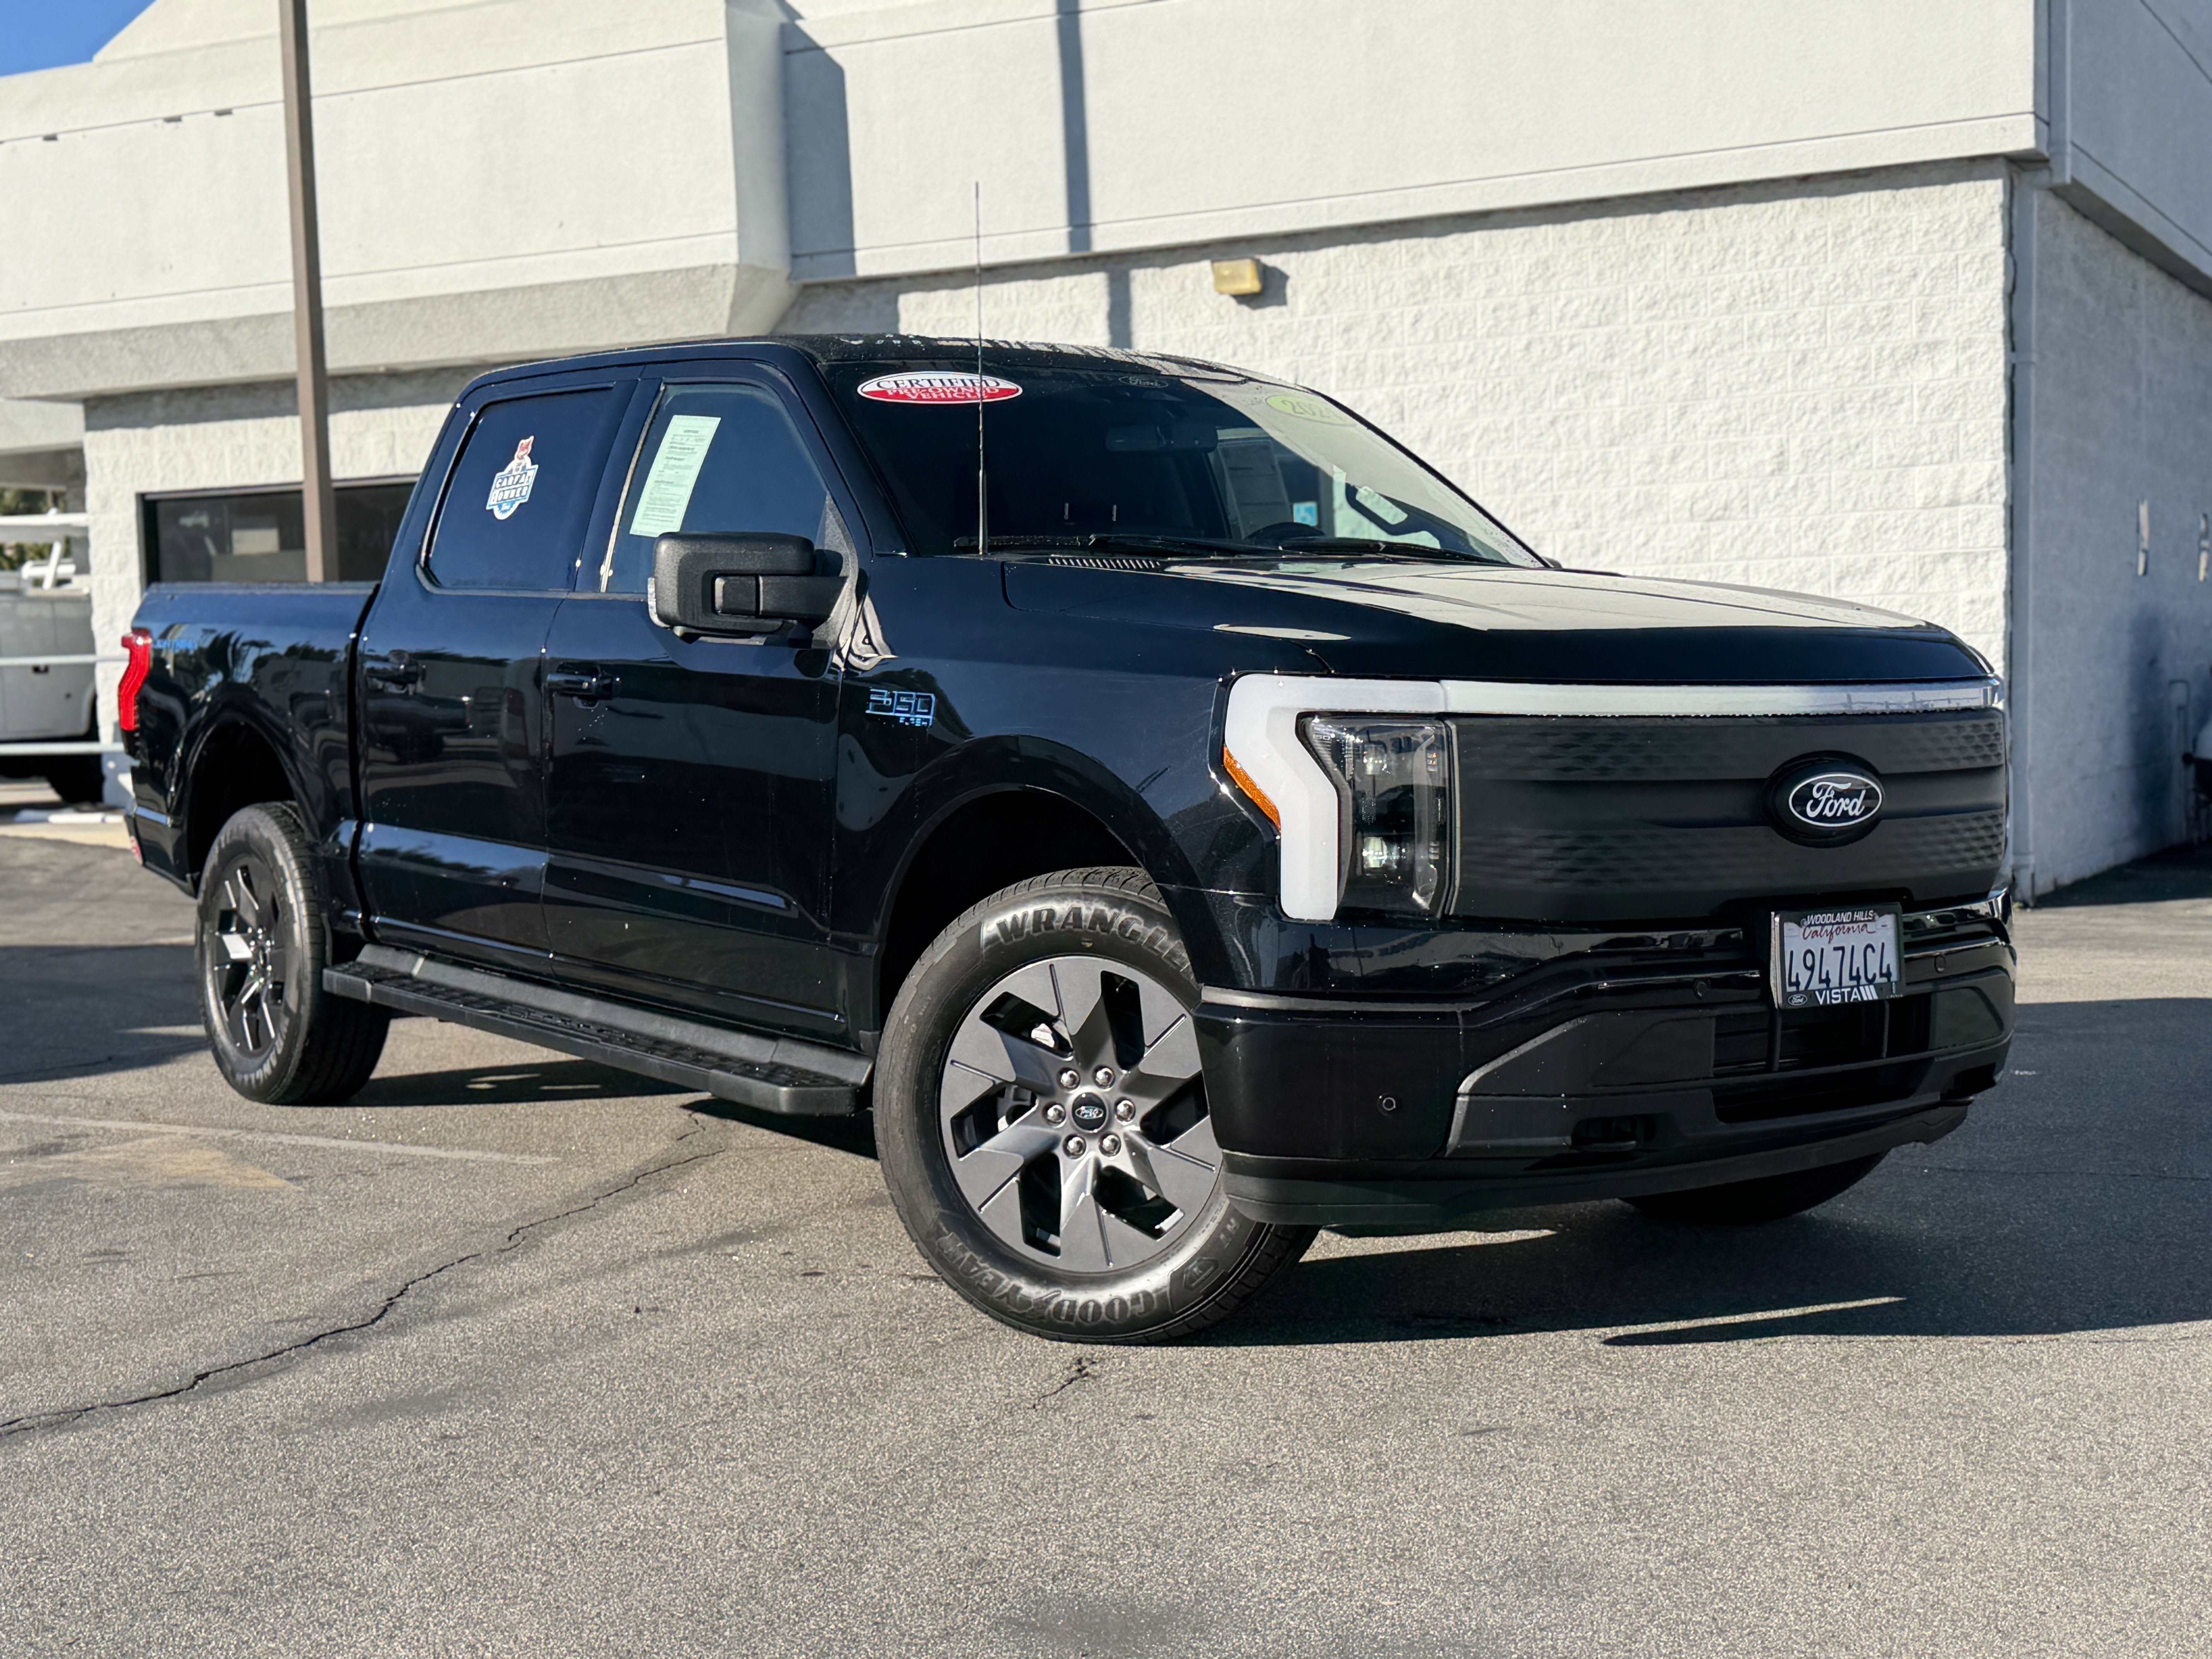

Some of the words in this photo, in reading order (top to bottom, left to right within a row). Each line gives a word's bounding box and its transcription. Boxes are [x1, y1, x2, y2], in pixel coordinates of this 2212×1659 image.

[876, 378, 1001, 390] CERTIFIED
[886, 386, 1000, 395] PRE-OWNED
[1806, 781, 1867, 818] Ford
[1807, 911, 1852, 925] WOODLAND
[1853, 910, 1874, 921] HILLS
[1802, 923, 1877, 944] California
[1788, 942, 1892, 991] 49474C4
[1815, 986, 1862, 1005] VISTA
